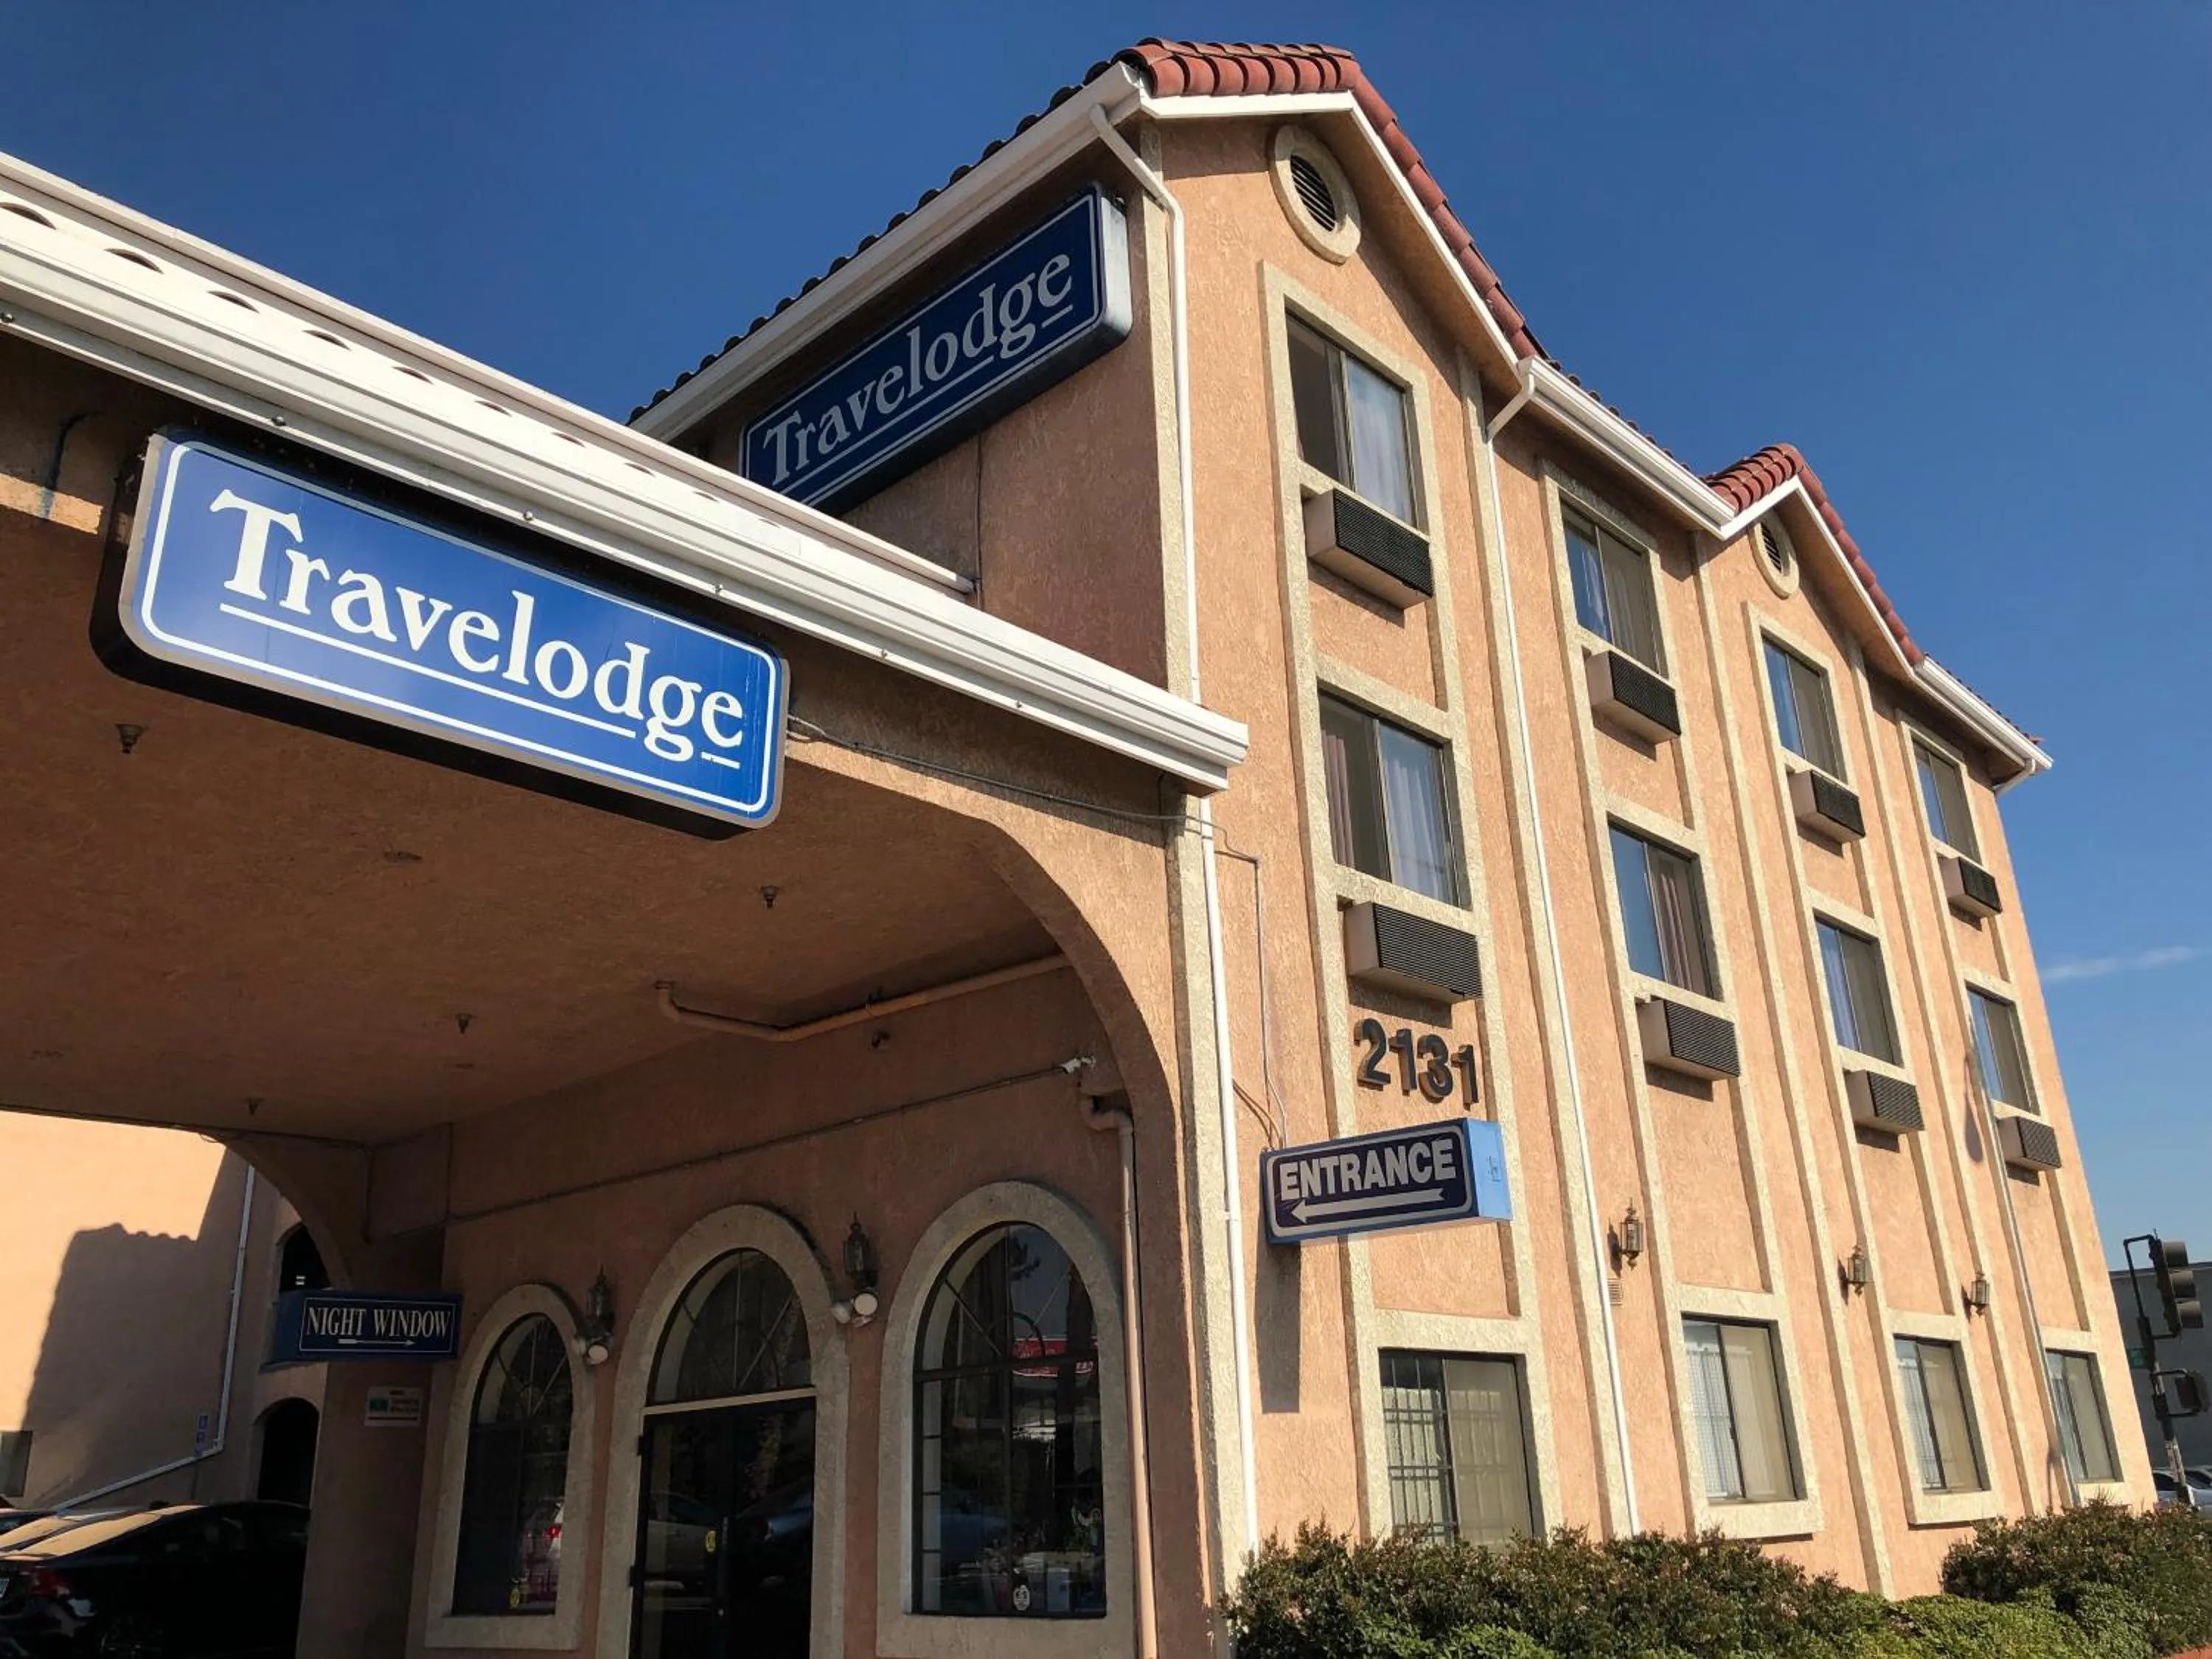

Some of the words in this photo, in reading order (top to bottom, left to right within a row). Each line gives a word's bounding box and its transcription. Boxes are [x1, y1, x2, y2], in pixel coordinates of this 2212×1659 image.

[763, 254, 1072, 487] Travelodge
[209, 488, 743, 762] Travelodge
[1354, 1018, 1479, 1107] 2131
[1279, 1138, 1457, 1201] ENTRANCE
[305, 1307, 366, 1336] NIGHT
[374, 1309, 451, 1338] WINDOW
